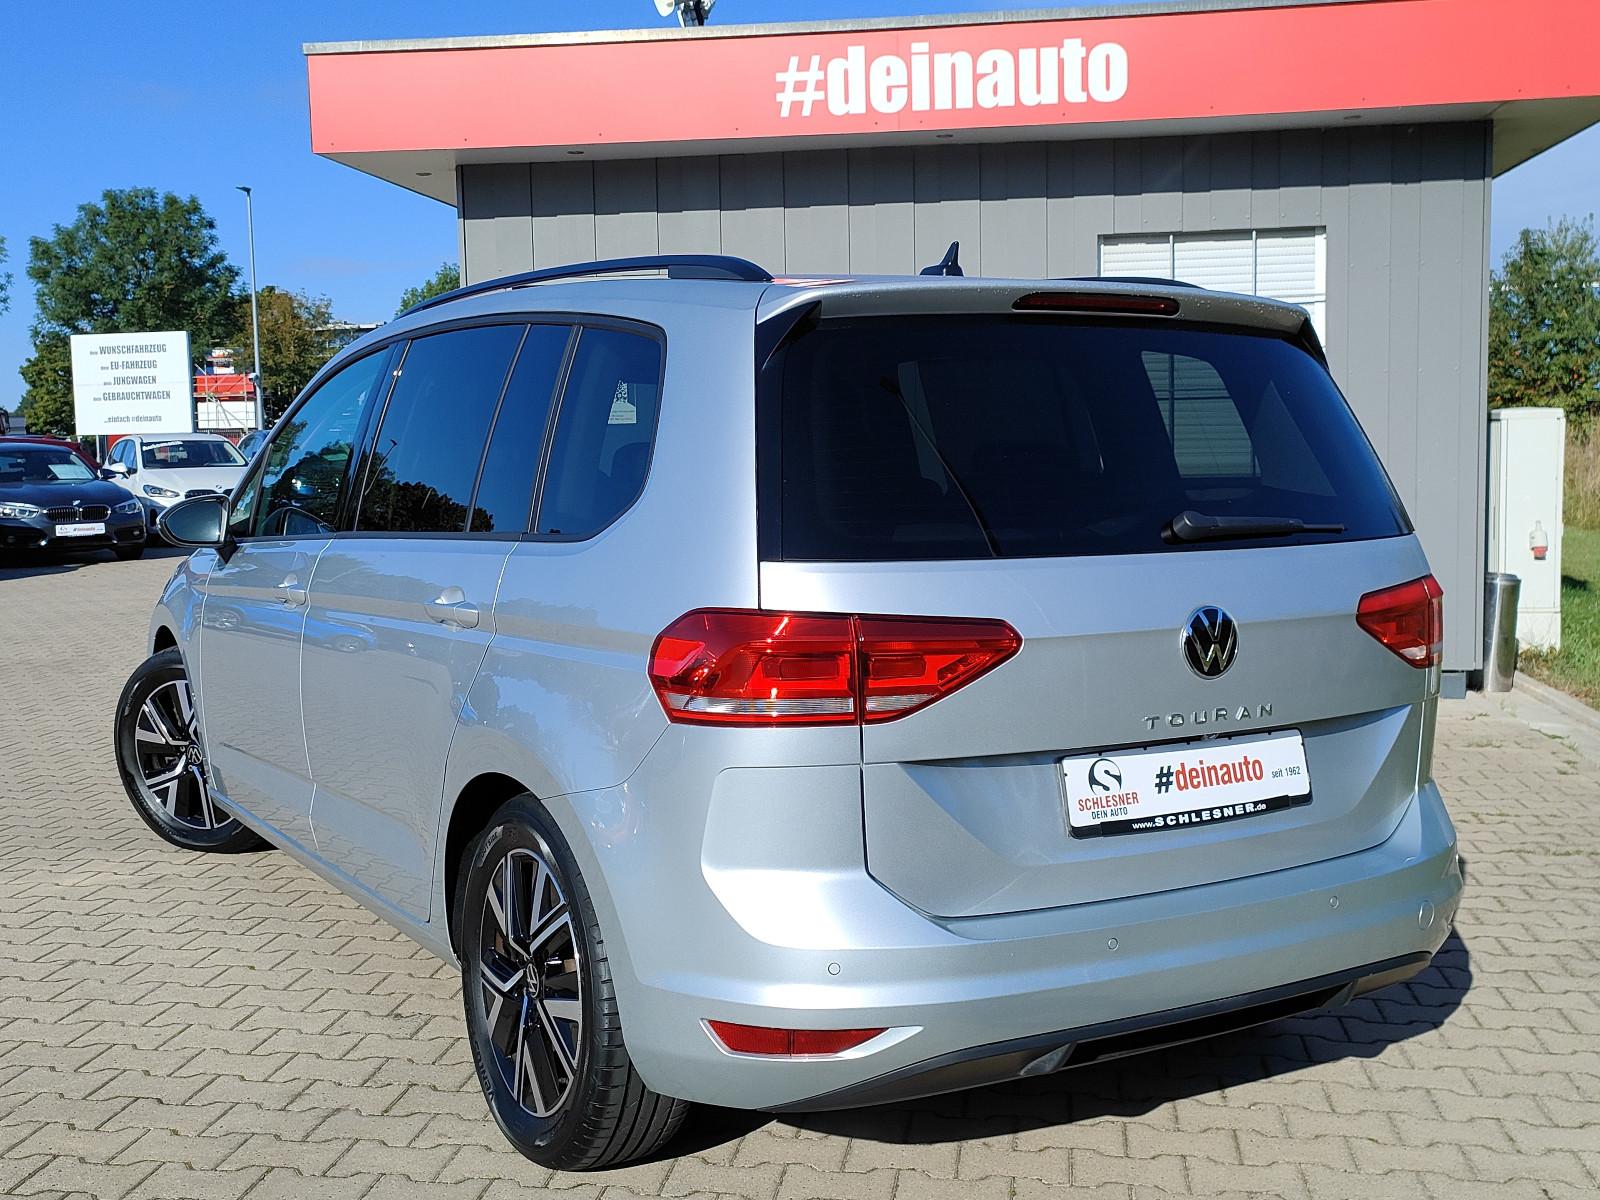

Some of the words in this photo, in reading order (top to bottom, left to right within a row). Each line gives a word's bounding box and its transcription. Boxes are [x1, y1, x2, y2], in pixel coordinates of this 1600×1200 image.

[775, 38, 1128, 118] #deinauto
[99, 344, 167, 355] WUNSCHFAHRZEUG
[110, 360, 158, 370] EU-FAHRZEUG
[113, 376, 157, 386] JUNGWAGEN
[102, 390, 171, 401] GEBRAUCHTWAGEN
[1142, 703, 1273, 730] TOURAN
[1154, 755, 1264, 794] #deinauto
[1271, 768, 1284, 779] seit
[1285, 765, 1301, 776] 1962
[1078, 792, 1139, 811] SCHLESNER
[1091, 810, 1108, 820] DEIN
[1110, 806, 1128, 817] AUTO
[1132, 802, 1267, 830] www.SCHLESNER.de
